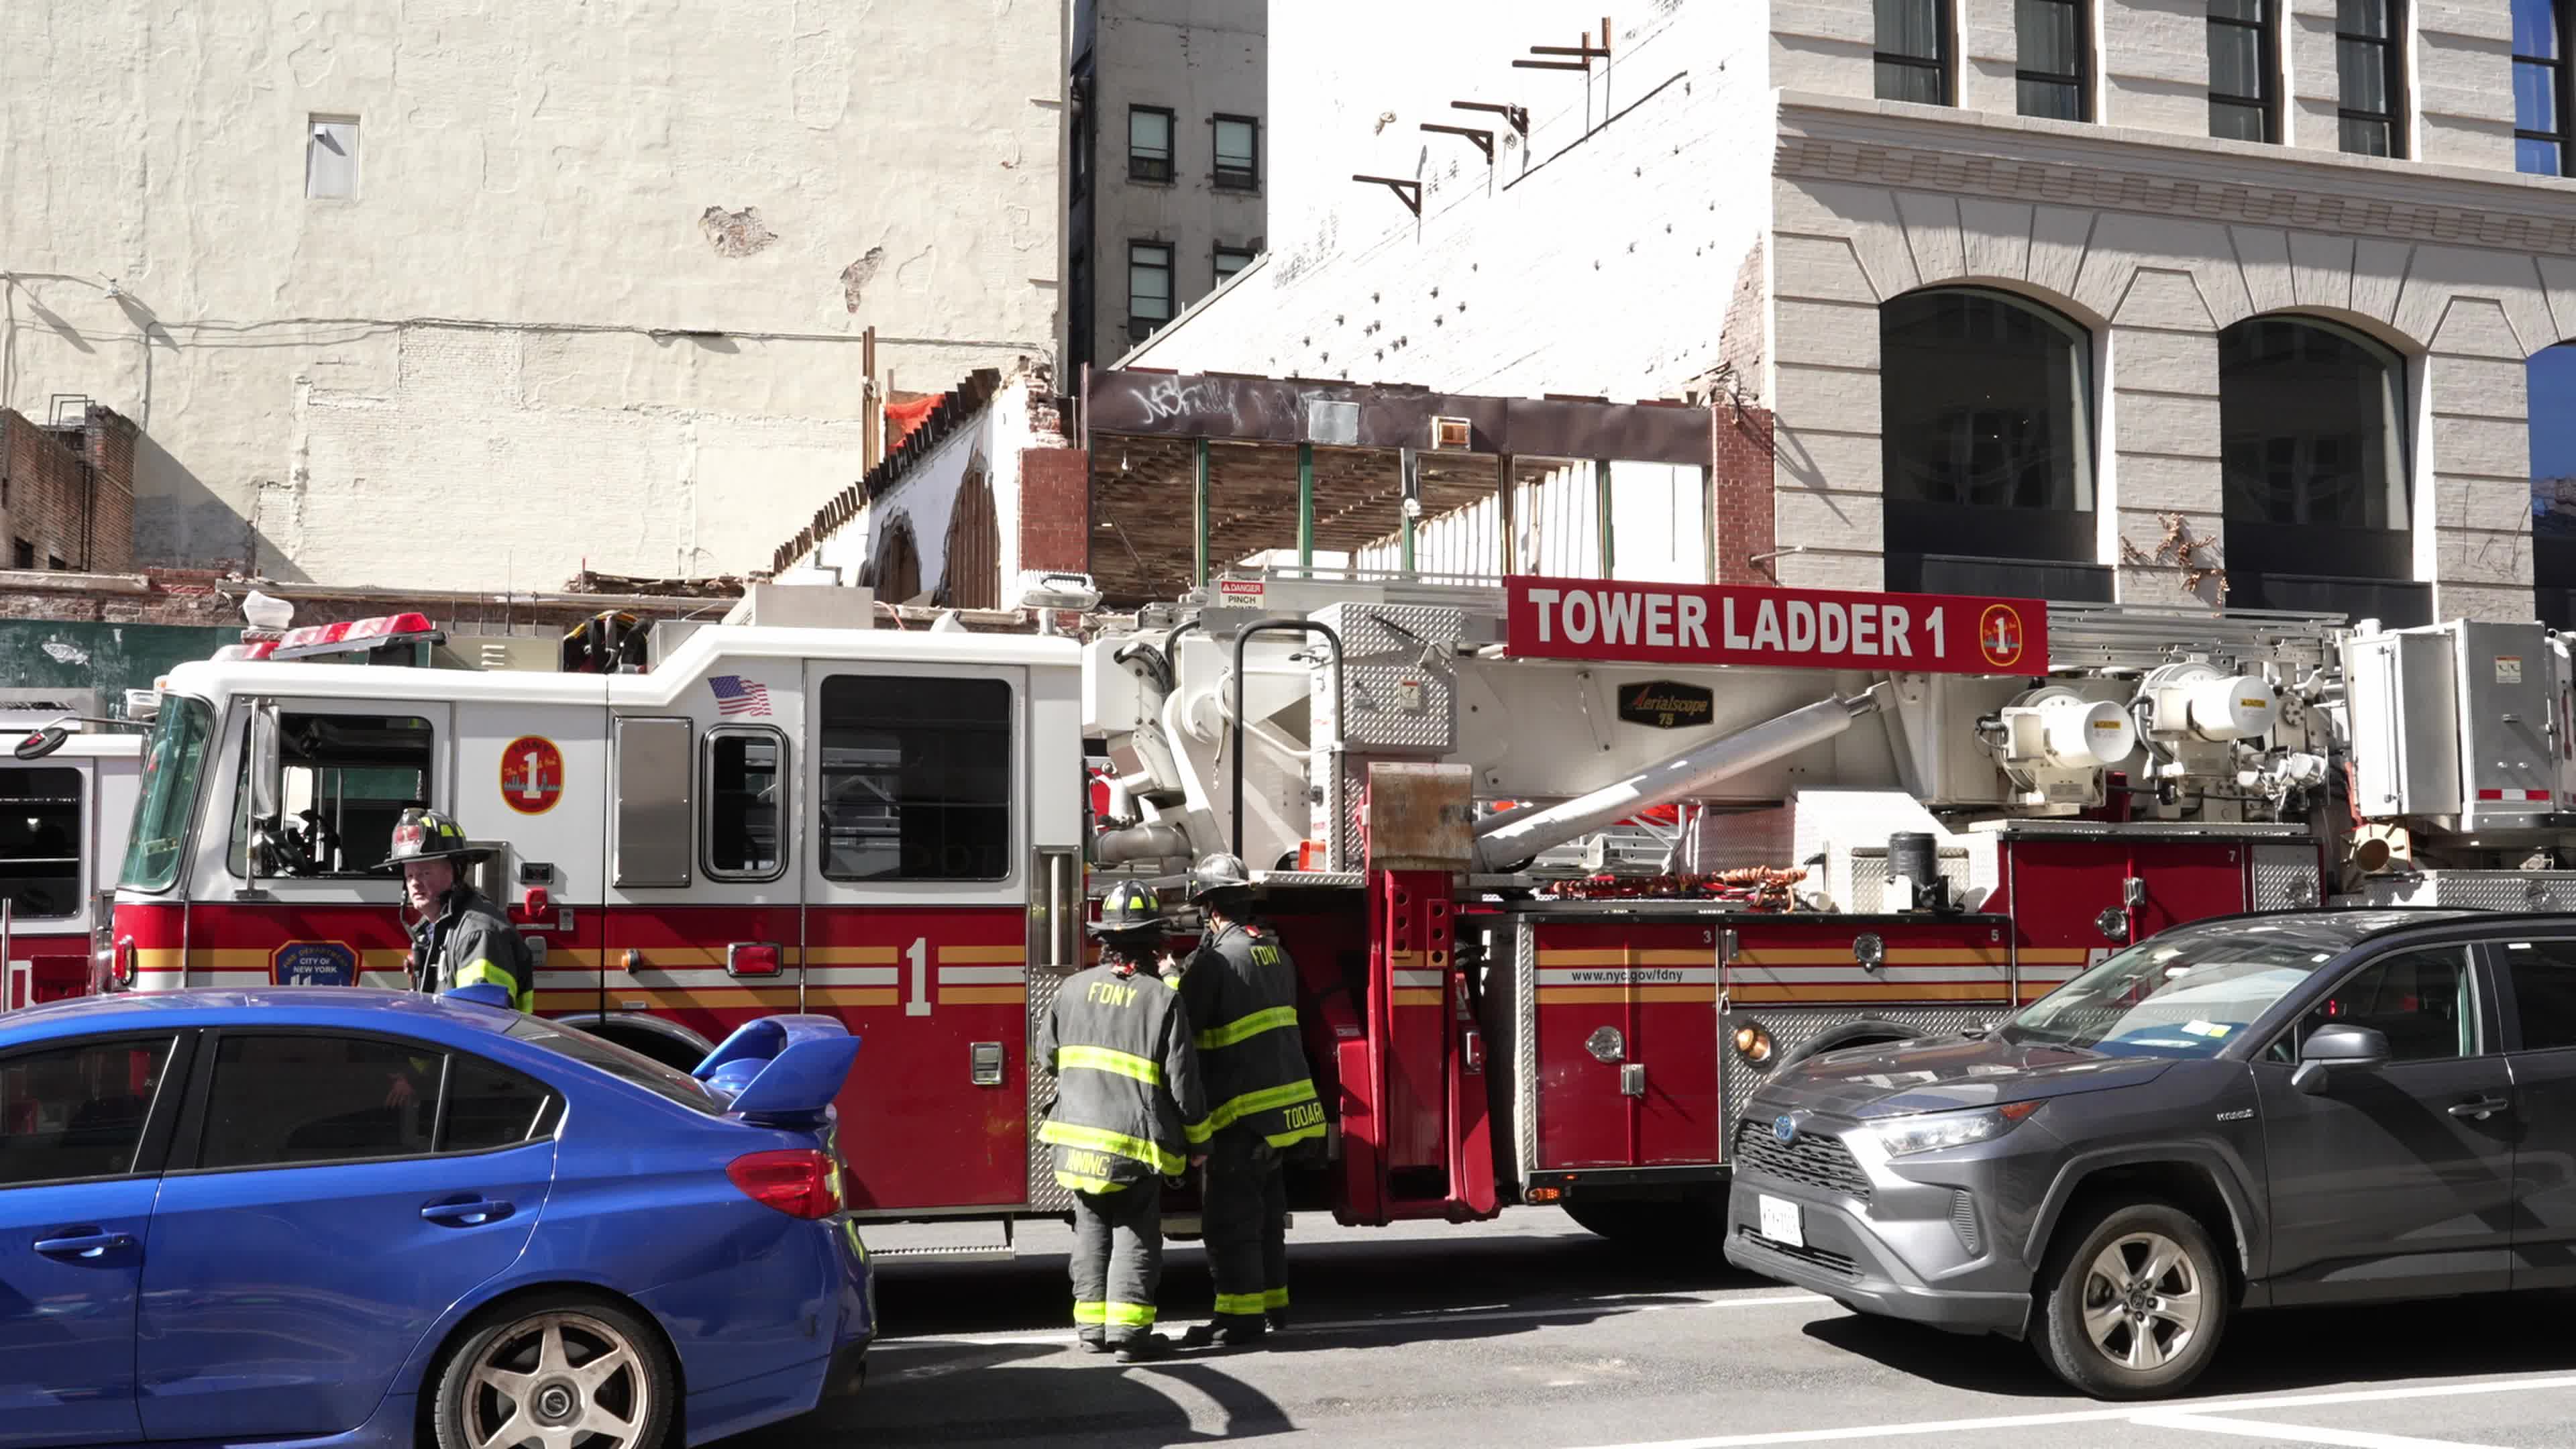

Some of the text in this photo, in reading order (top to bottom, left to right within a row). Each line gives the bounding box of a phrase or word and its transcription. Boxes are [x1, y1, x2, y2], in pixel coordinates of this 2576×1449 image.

[1230, 584, 1261, 593] DANGER
[1228, 595, 1256, 604] PINCH
[1528, 588, 1945, 658] TOWER LADDER 1
[1995, 616, 2008, 654] 1
[1631, 686, 1707, 716] Aerialscope
[1658, 713, 1674, 725] 75
[523, 751, 541, 799] 1
[2229, 850, 2236, 862] 7
[1703, 930, 1712, 943] 3
[1990, 929, 1999, 942] 5
[300, 957, 332, 965] CITY OF
[1250, 945, 1281, 967] FDNY
[906, 937, 931, 1016] 1
[1572, 969, 1683, 983] www.nyc.gov/fdny
[1087, 981, 1138, 1008] FDNY
[1283, 1102, 1326, 1130] TODAR
